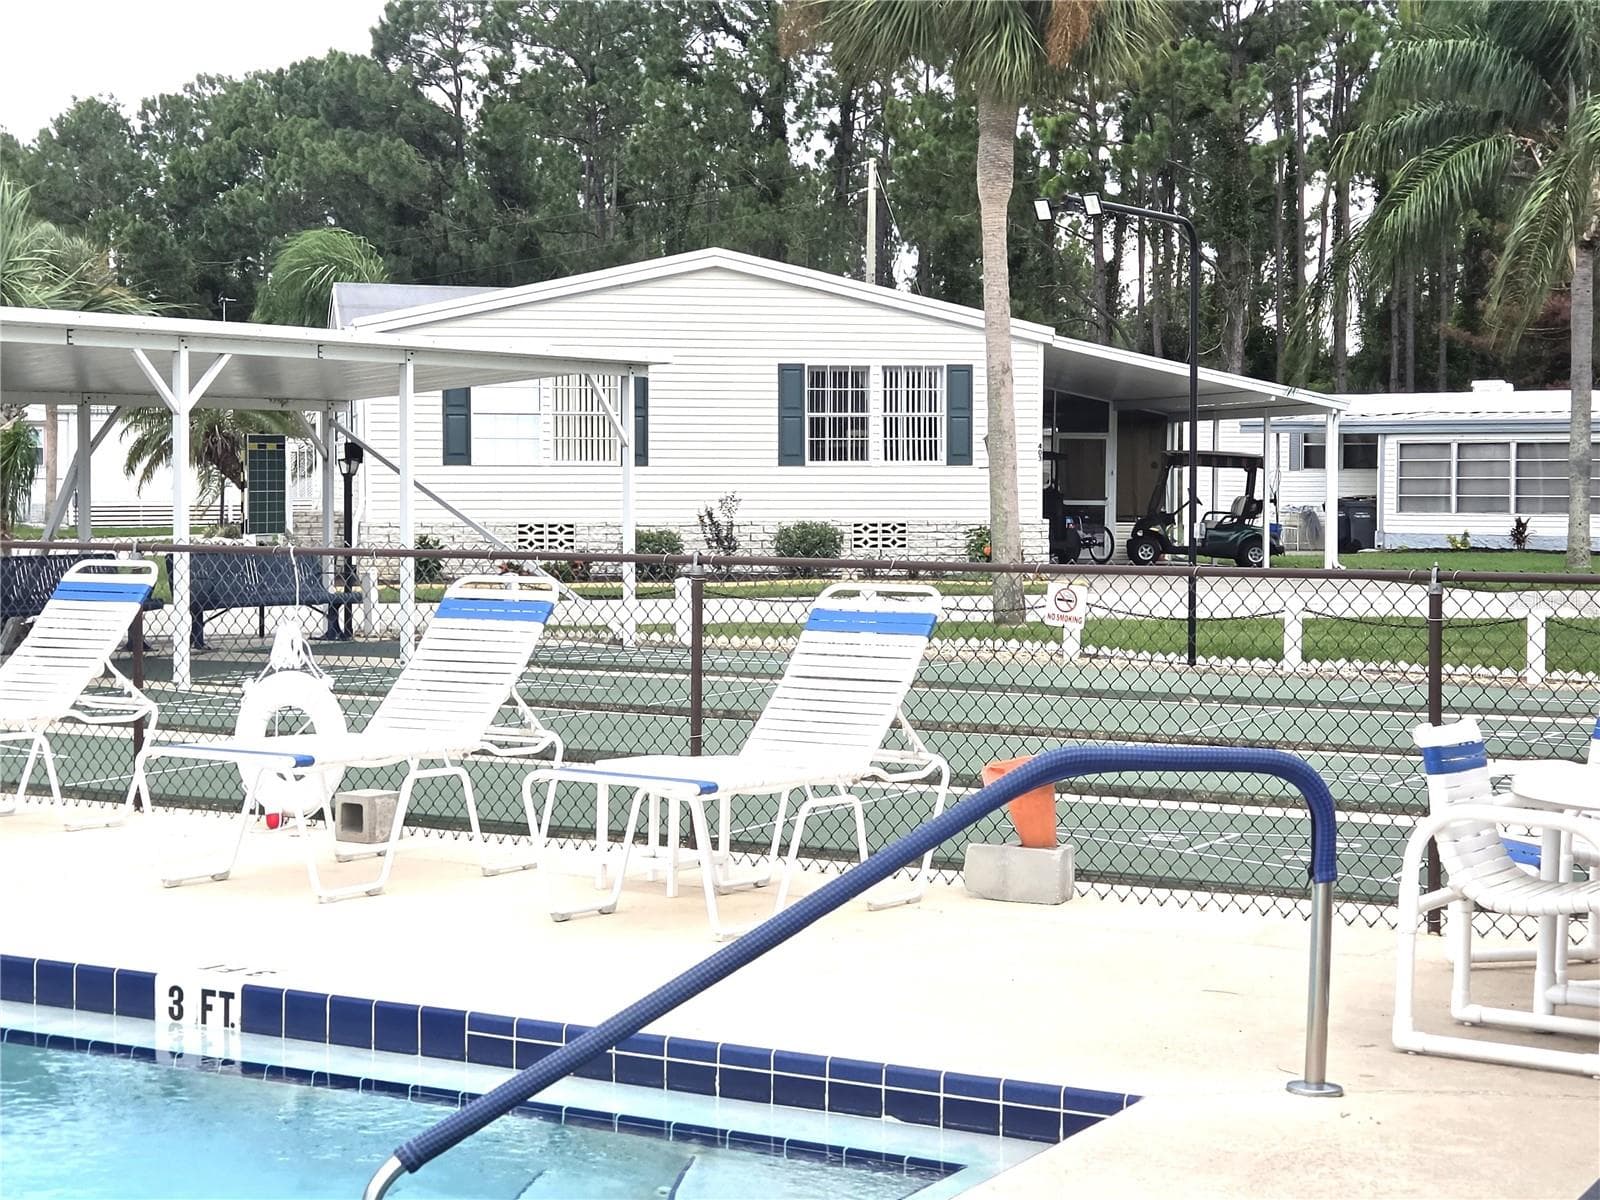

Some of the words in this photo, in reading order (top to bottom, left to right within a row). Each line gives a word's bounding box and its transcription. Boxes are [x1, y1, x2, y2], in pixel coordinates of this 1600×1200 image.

[1047, 613, 1056, 621] NO
[1056, 613, 1083, 625] SMOKING
[168, 985, 184, 1021] 3
[201, 988, 235, 1028] FT.
